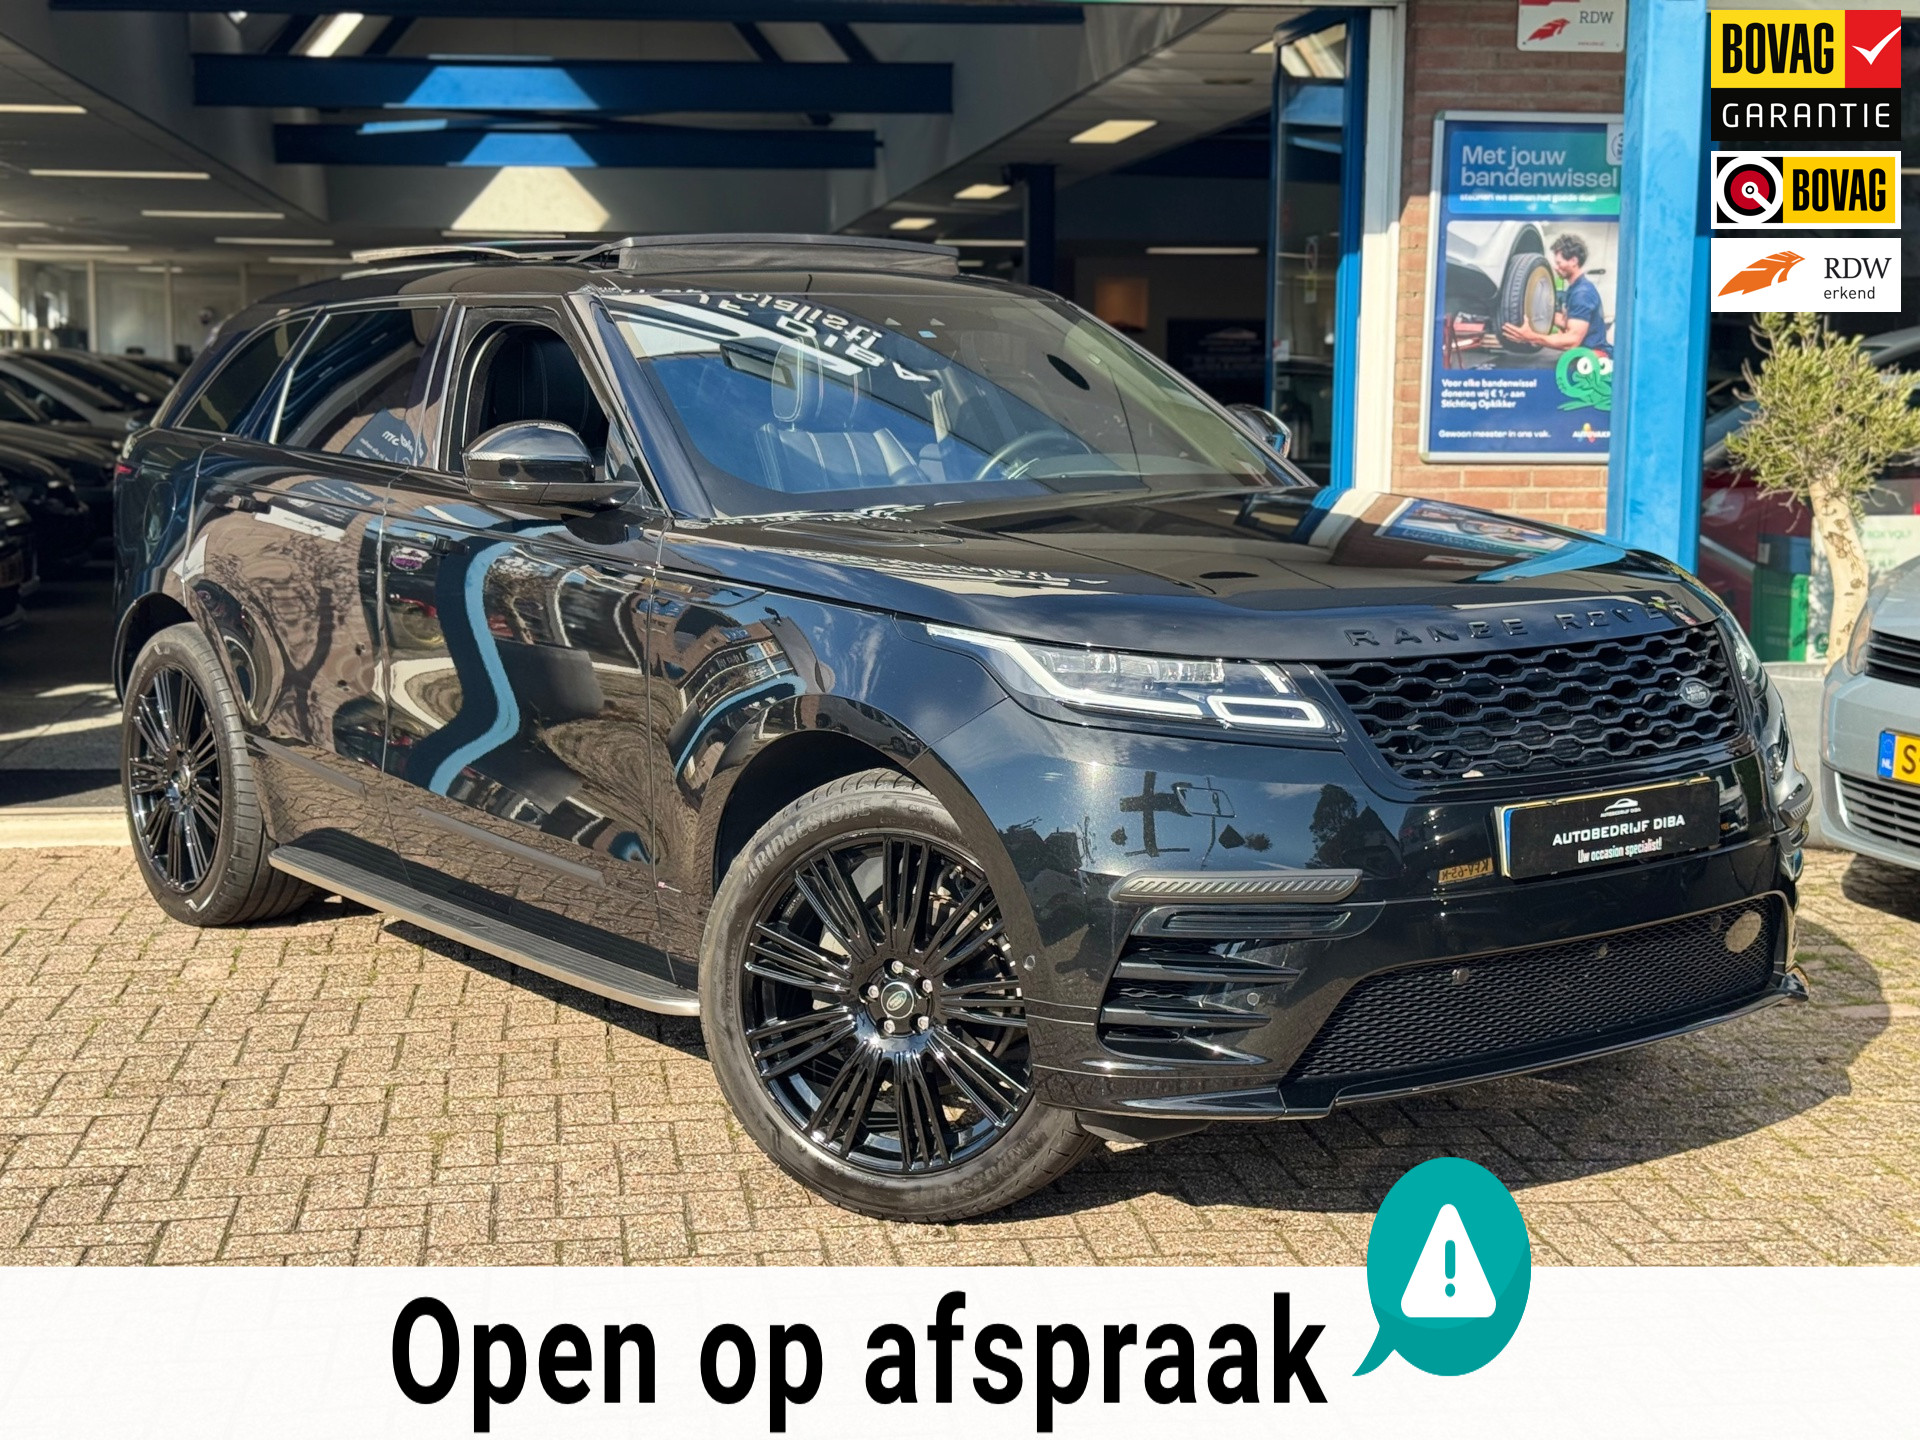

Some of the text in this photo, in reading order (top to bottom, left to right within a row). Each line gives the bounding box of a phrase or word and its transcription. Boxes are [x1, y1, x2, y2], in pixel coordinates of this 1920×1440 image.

[1579, 11, 1614, 24] RDW
[1462, 145, 1567, 170] Met jouw
[1460, 166, 1618, 188] bandenwissel
[1441, 378, 1537, 388] Voor elke bandenwissel
[1441, 388, 1476, 398] doneren
[1477, 389, 1489, 400] wij
[1510, 390, 1526, 398] aan
[1441, 399, 1517, 410] Stichting Opkikker
[1438, 429, 1472, 438] Gewoon
[1508, 429, 1516, 438] in
[1517, 430, 1533, 438] ons
[1344, 618, 1528, 647] RANGE
[1881, 757, 1893, 770] NL
[1552, 814, 1686, 846] AUTOBEDRIJF DIBA
[1577, 836, 1663, 864] Uw occasion specialist!
